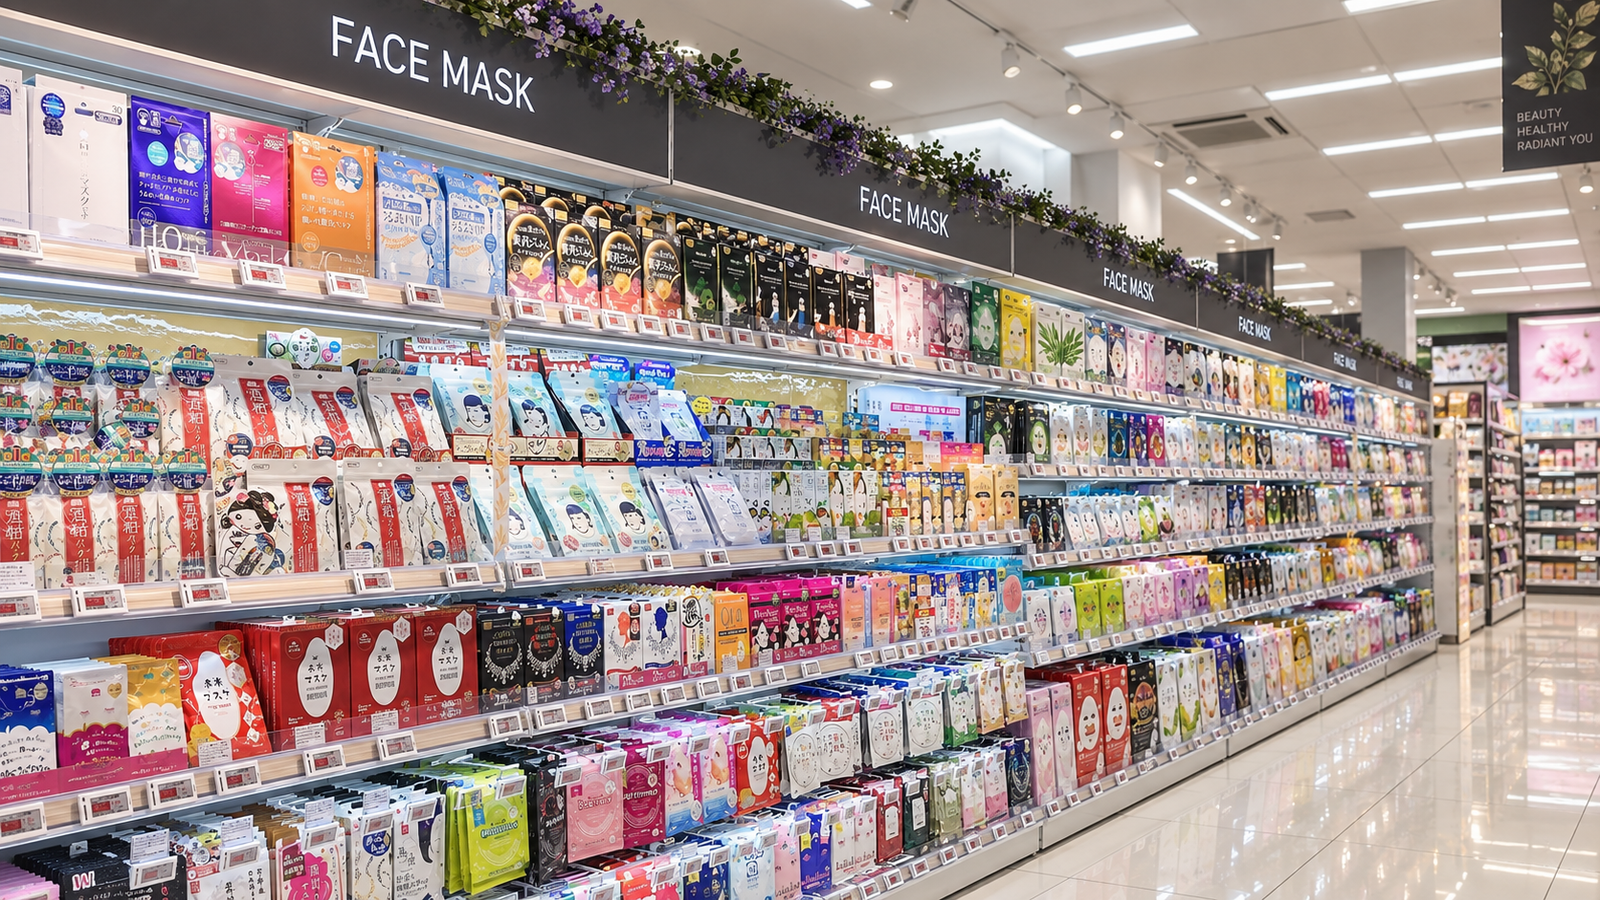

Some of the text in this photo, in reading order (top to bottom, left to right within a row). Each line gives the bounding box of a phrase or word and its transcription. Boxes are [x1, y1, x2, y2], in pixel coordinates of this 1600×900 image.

[332, 16, 535, 112] FACE MASK
[111, 105, 123, 115] 30
[1517, 107, 1562, 123] BEAUTY
[1517, 121, 1569, 137] HEALTHY
[1517, 133, 1593, 151] RADIANT YOU
[860, 185, 949, 238] FACE MASK
[1103, 267, 1155, 302] FACE MASK
[1238, 316, 1272, 342] FACE MASK
